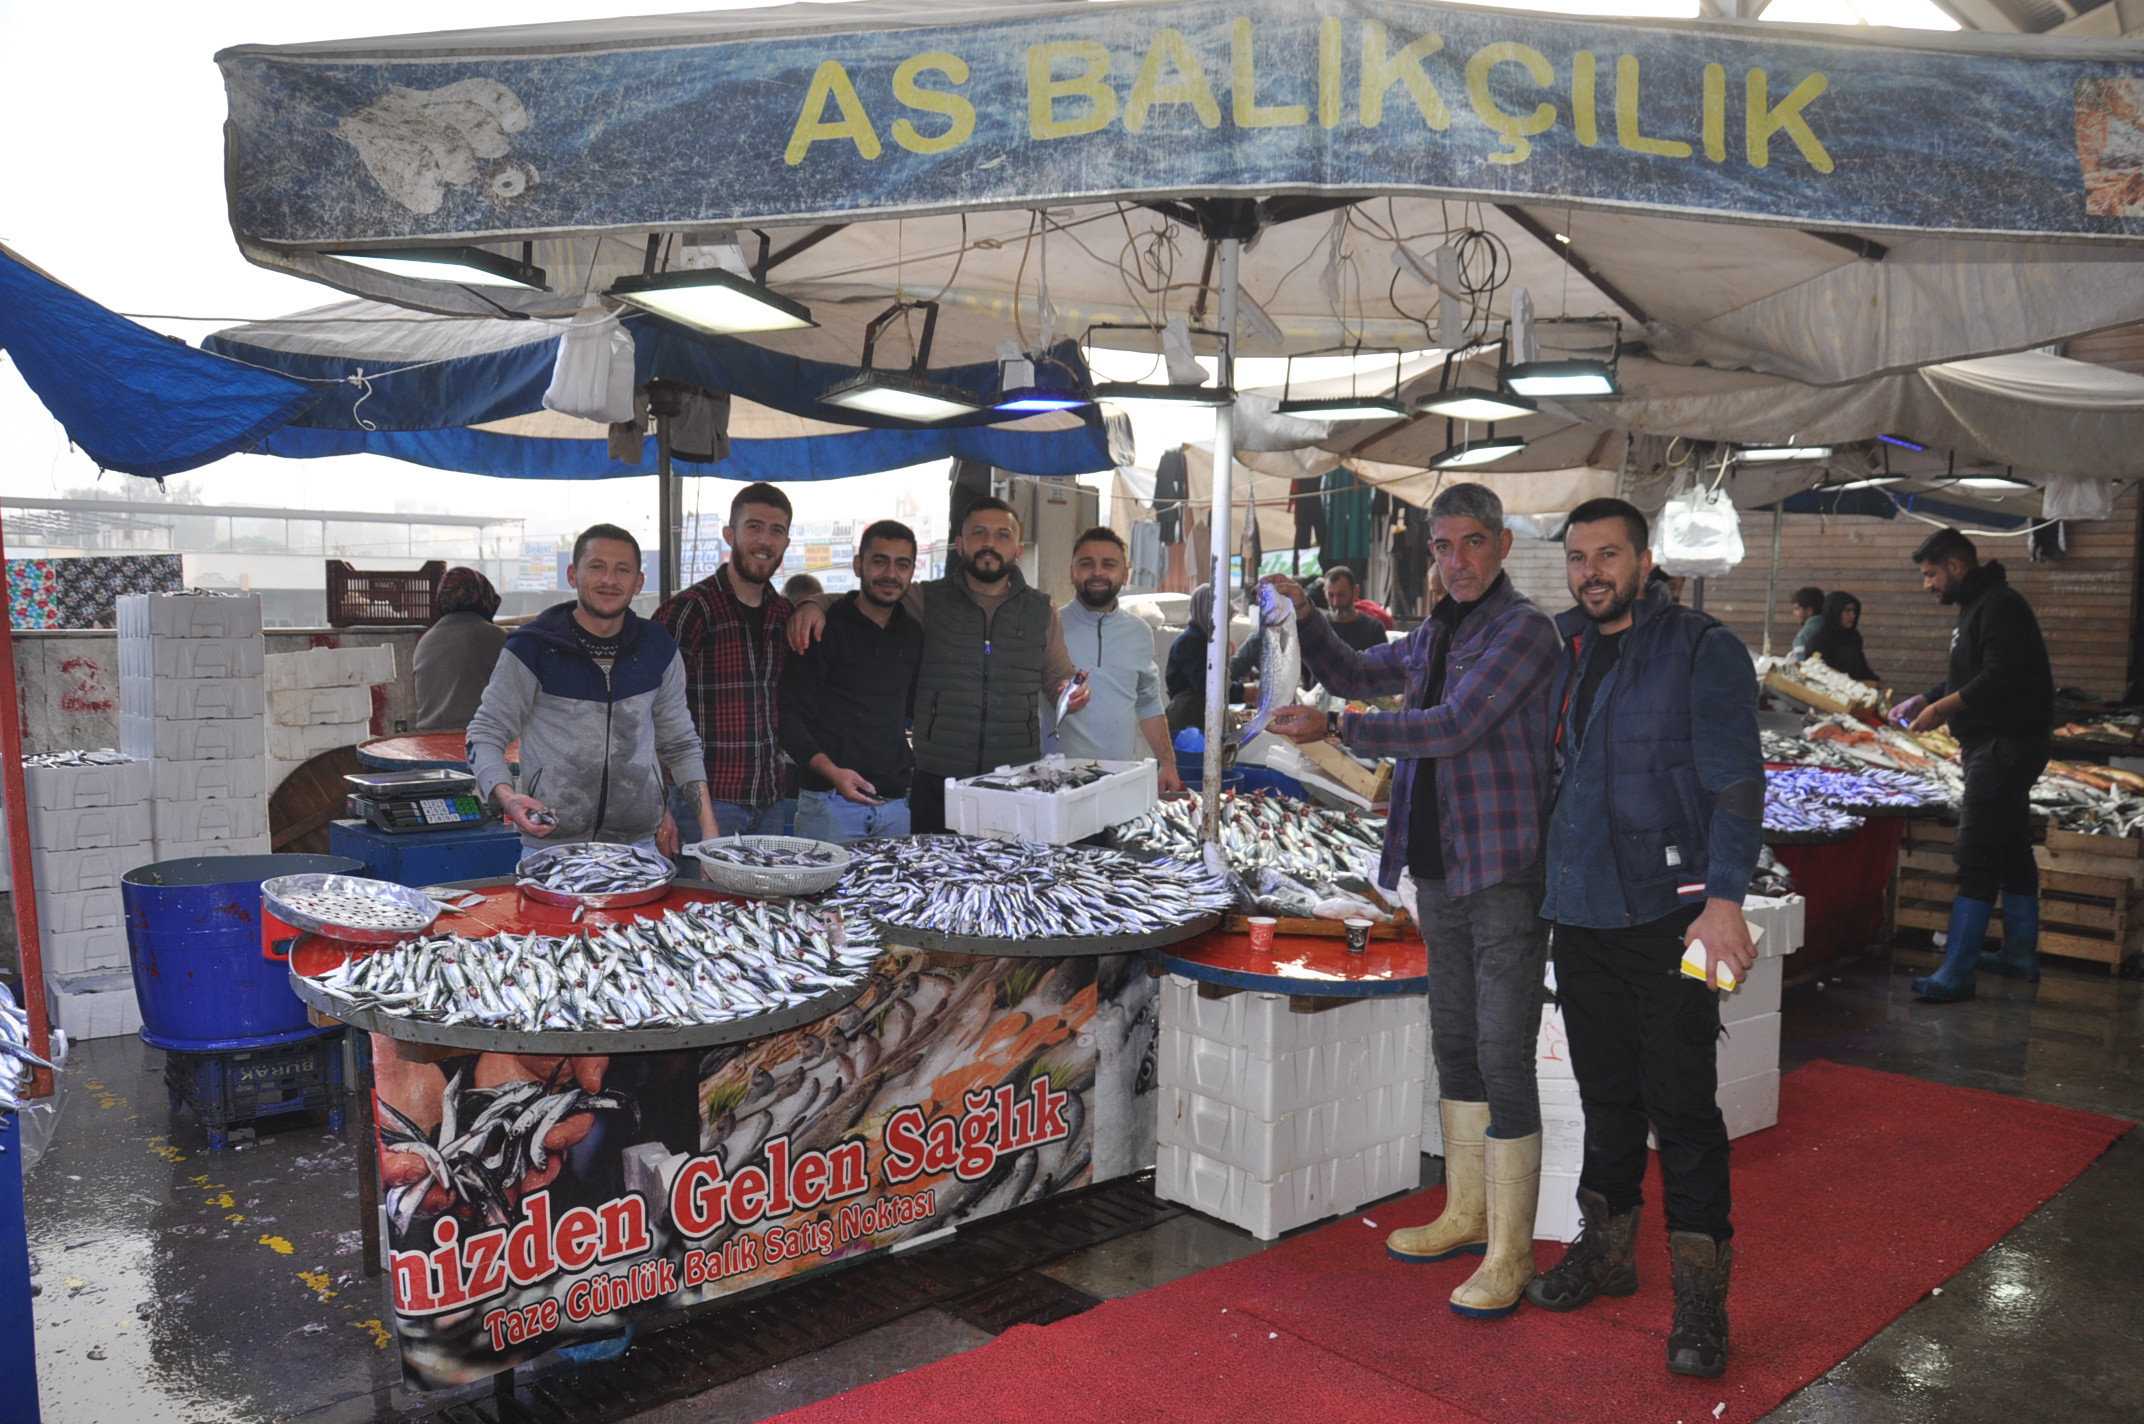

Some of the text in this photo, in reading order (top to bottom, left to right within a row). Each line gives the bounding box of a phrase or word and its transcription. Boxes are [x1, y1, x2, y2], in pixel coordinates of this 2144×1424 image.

[783, 16, 1835, 174] AS BALIKÇILIK
[241, 1061, 314, 1081] BURAK
[671, 1134, 869, 1238] Gelen
[884, 1074, 1069, 1182] Sağlık
[483, 1189, 935, 1351] Taze Günlük Balık Satış Noktası
